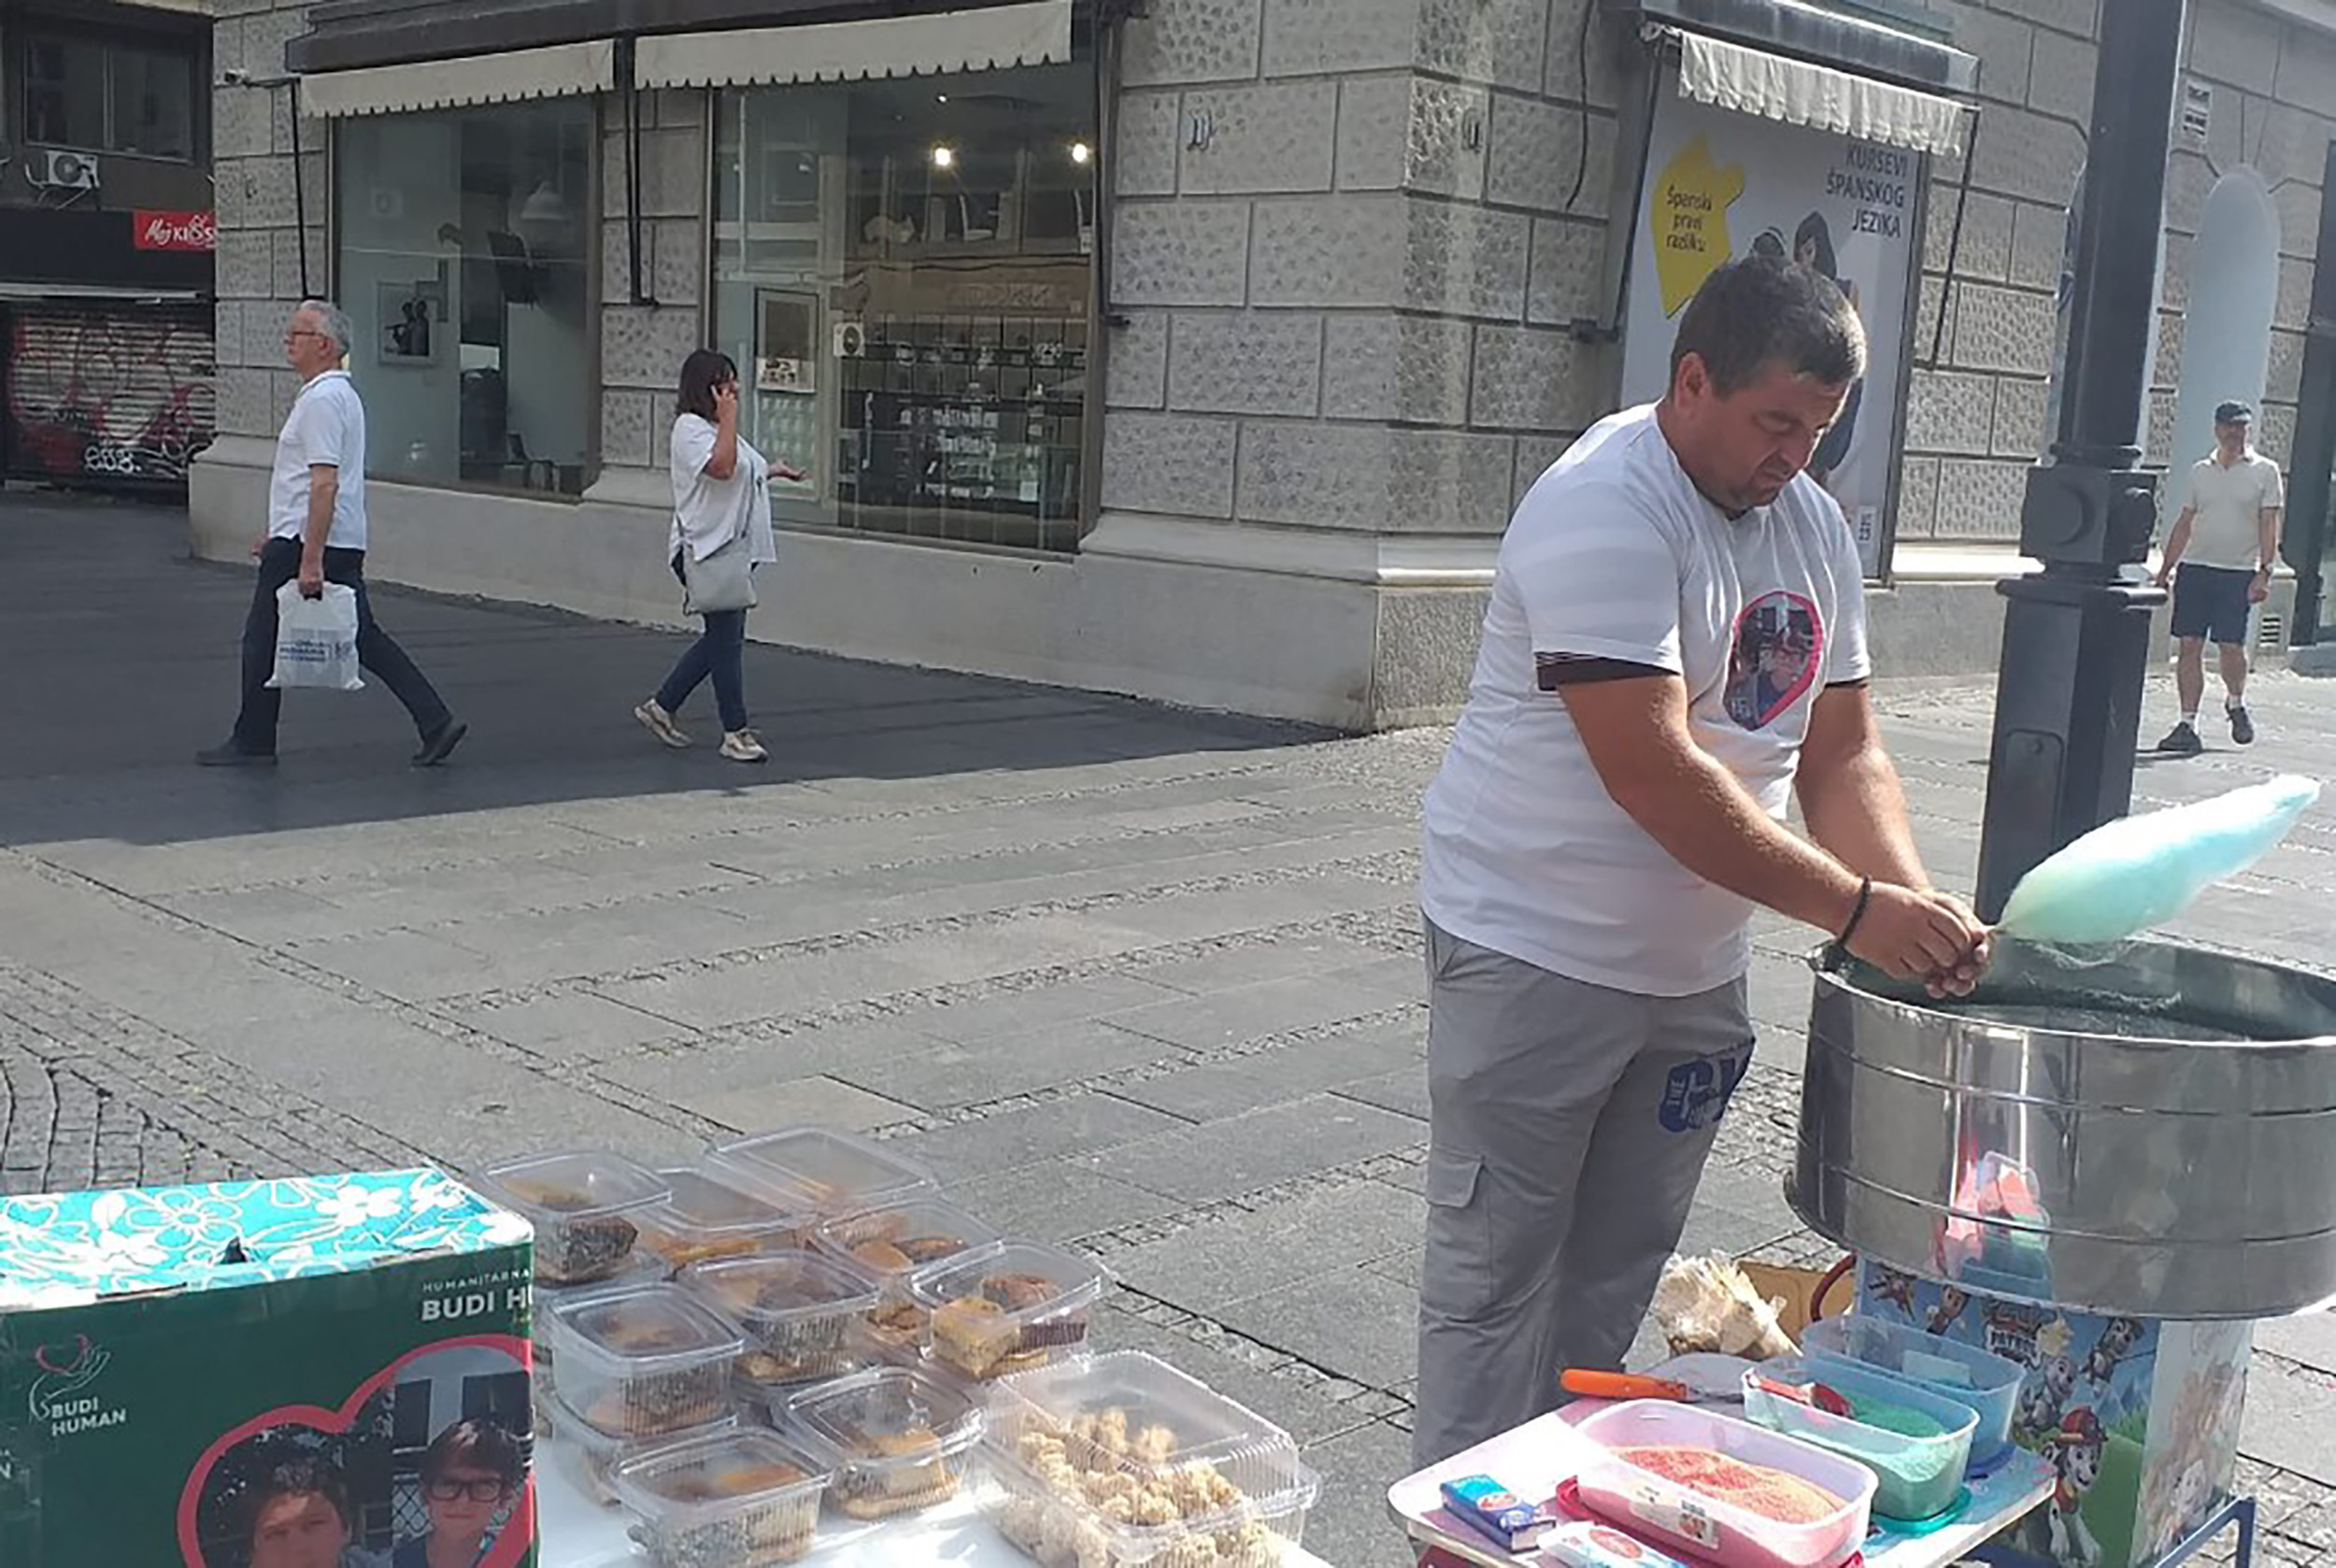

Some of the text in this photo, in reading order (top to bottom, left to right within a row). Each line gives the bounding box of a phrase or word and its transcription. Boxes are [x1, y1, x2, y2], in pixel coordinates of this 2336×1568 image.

[1846, 144, 1907, 178] KURSEVI
[1826, 167, 1904, 207] ŠPANSKOG
[1852, 208, 1901, 237] JEZIKA
[421, 1290, 495, 1320] BUDI
[51, 1396, 98, 1418] BUDI
[51, 1409, 126, 1436] HUMAN
